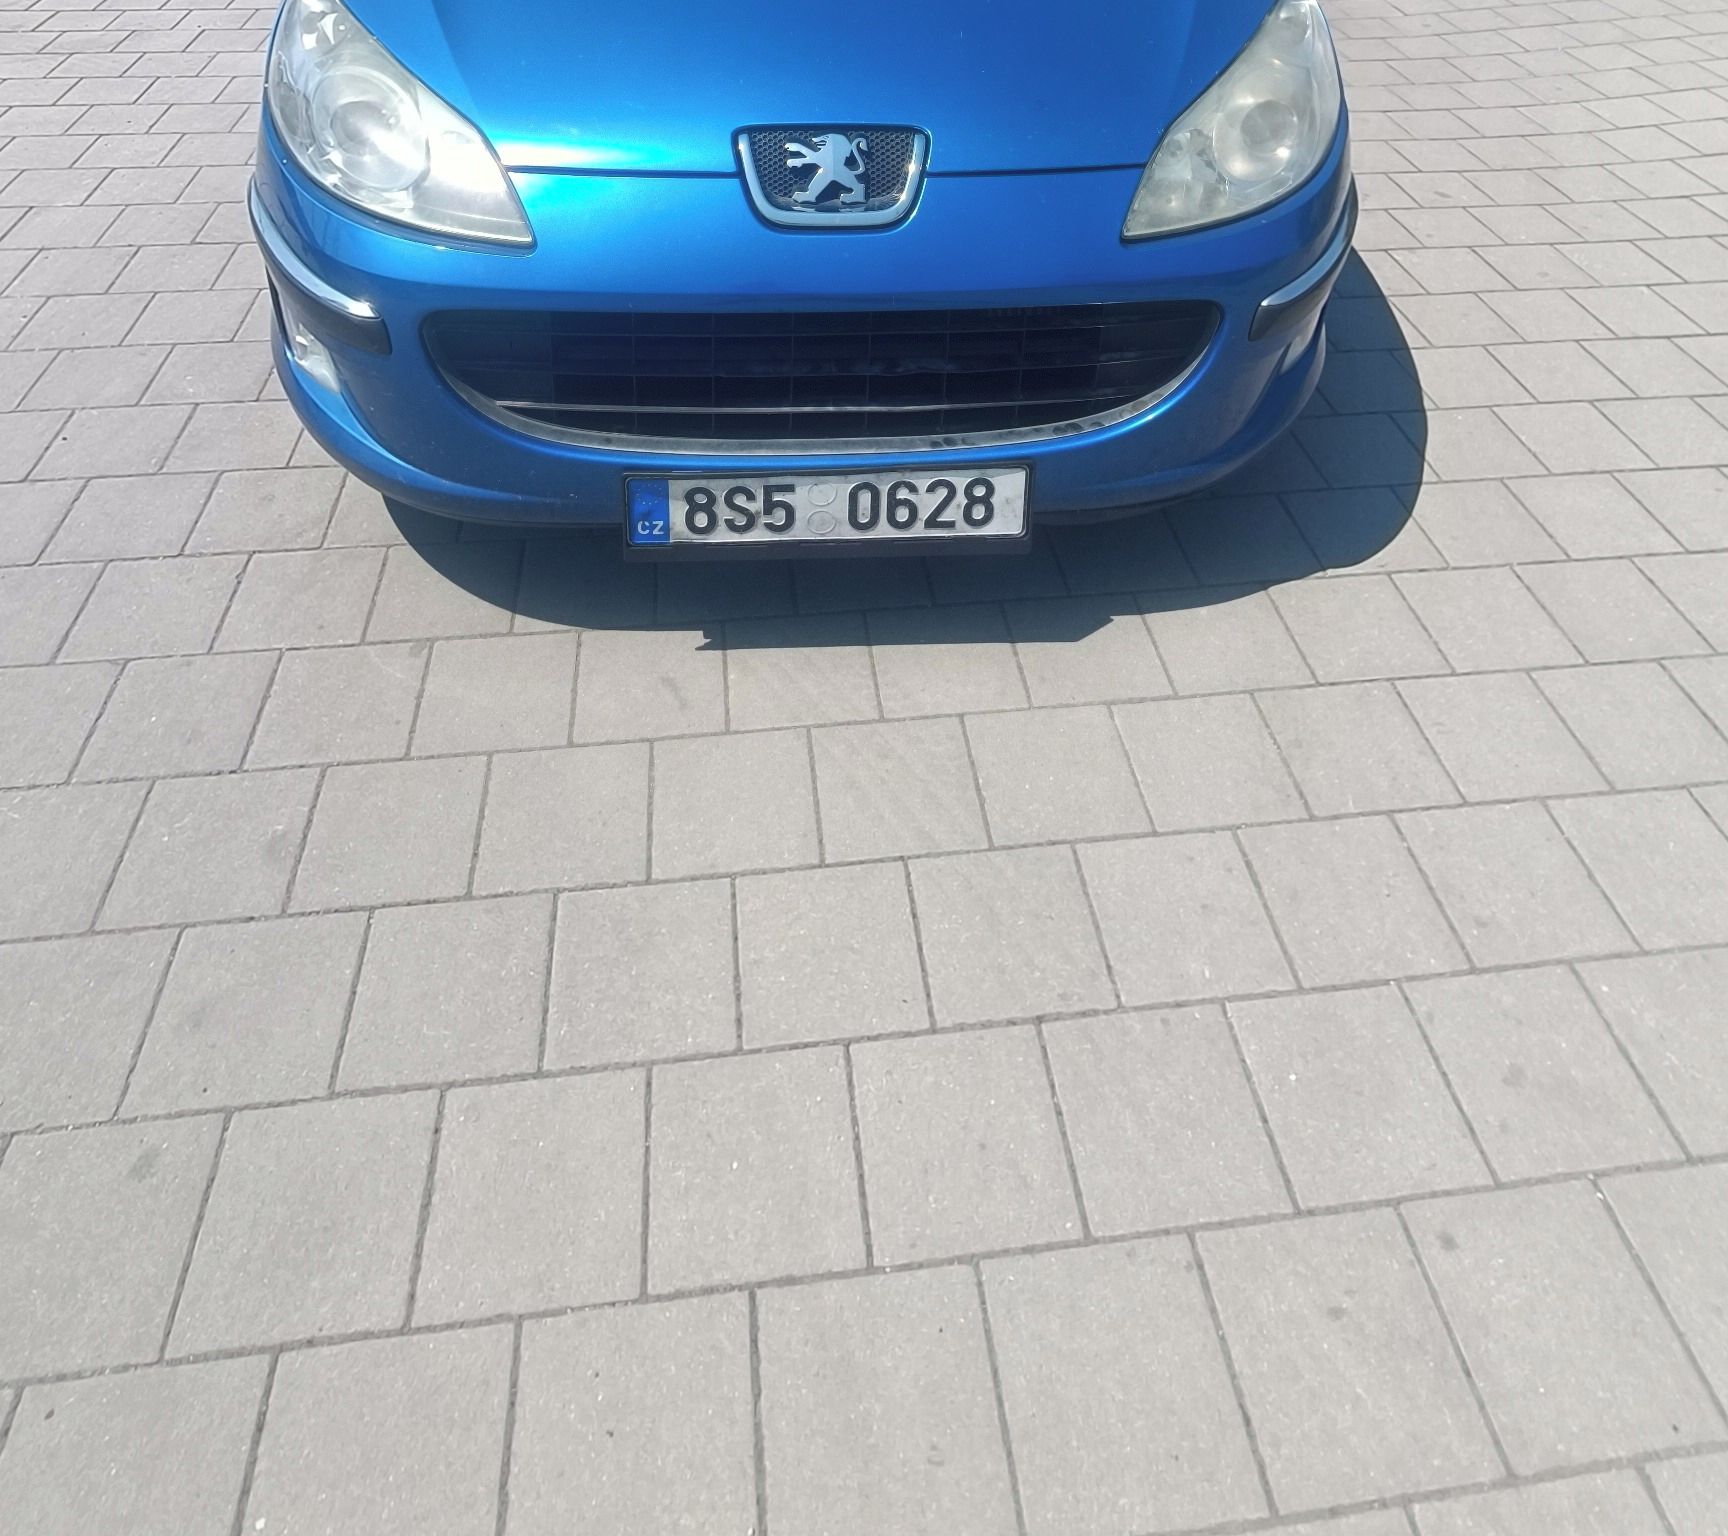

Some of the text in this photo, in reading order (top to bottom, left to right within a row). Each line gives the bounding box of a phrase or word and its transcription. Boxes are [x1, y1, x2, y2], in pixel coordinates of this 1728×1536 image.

[684, 477, 996, 535] 8S5 0628
[637, 520, 664, 535] CZ
